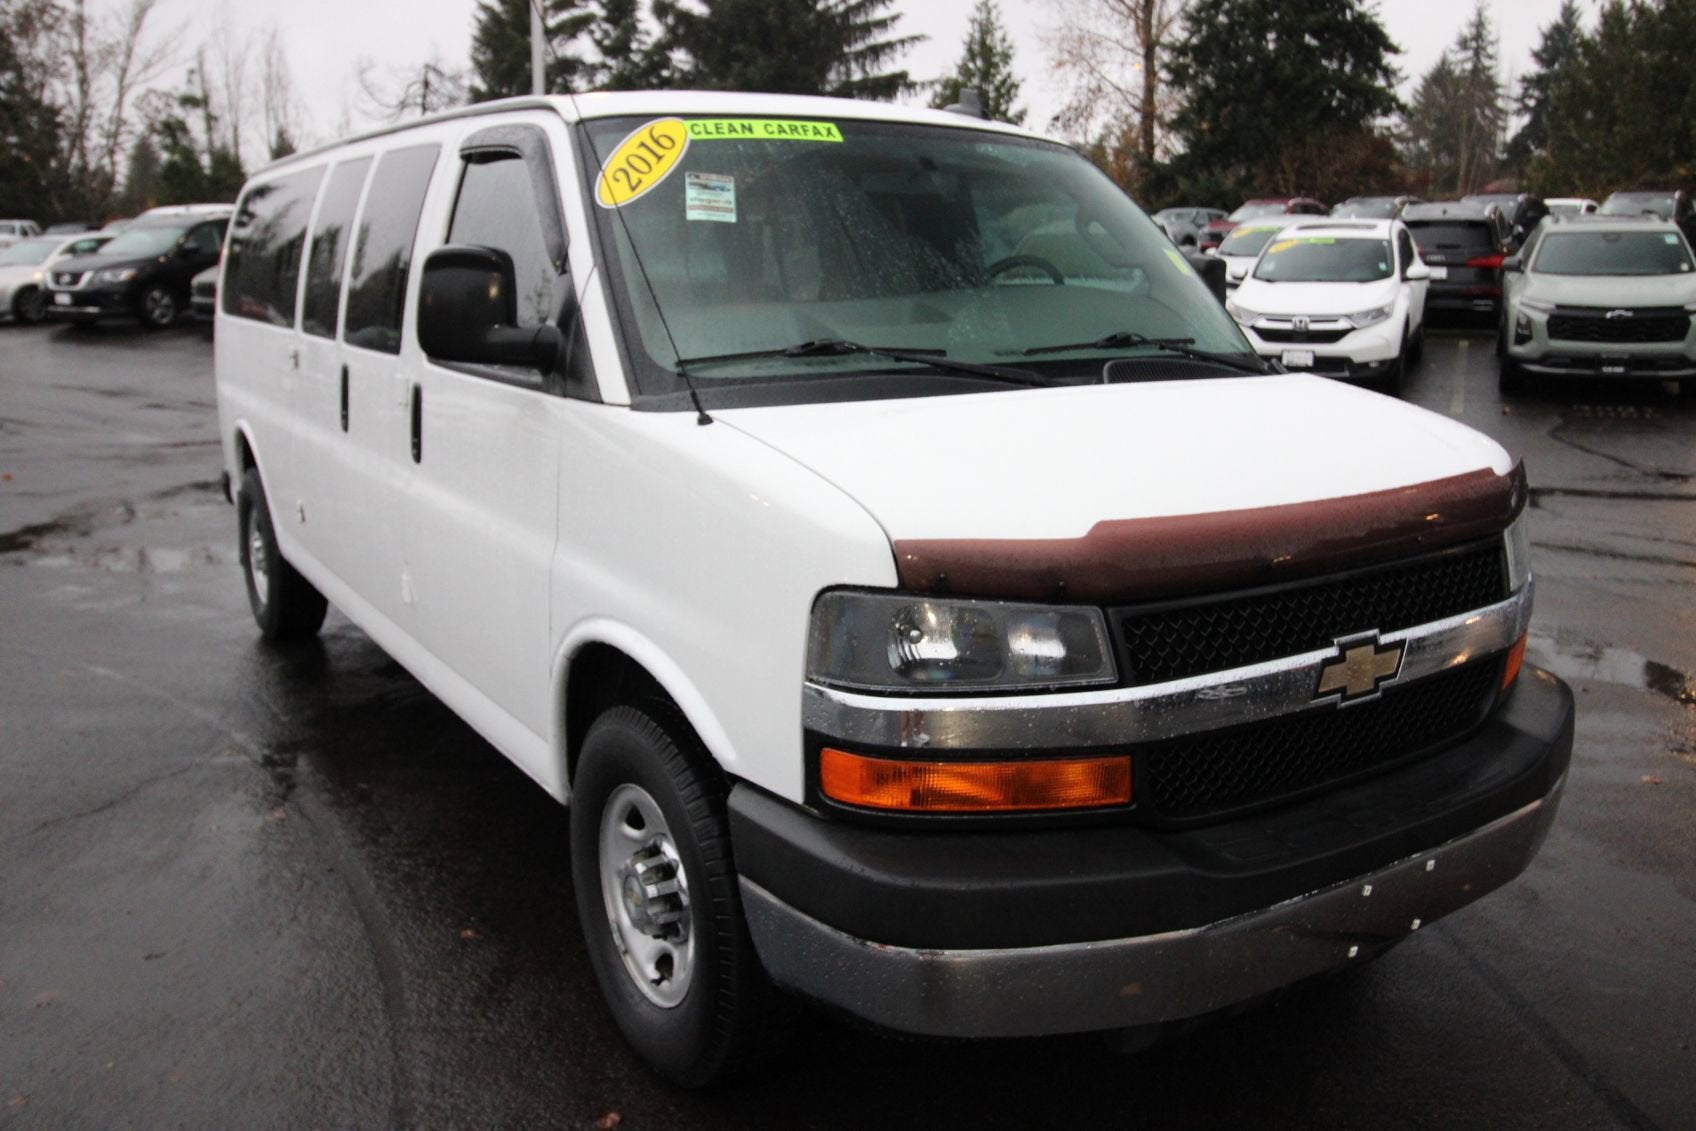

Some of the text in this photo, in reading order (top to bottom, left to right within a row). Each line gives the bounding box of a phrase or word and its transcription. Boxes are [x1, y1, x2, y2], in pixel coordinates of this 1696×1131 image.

[690, 122, 836, 138] CLEAN CARFAX
[612, 126, 676, 192] 2016
